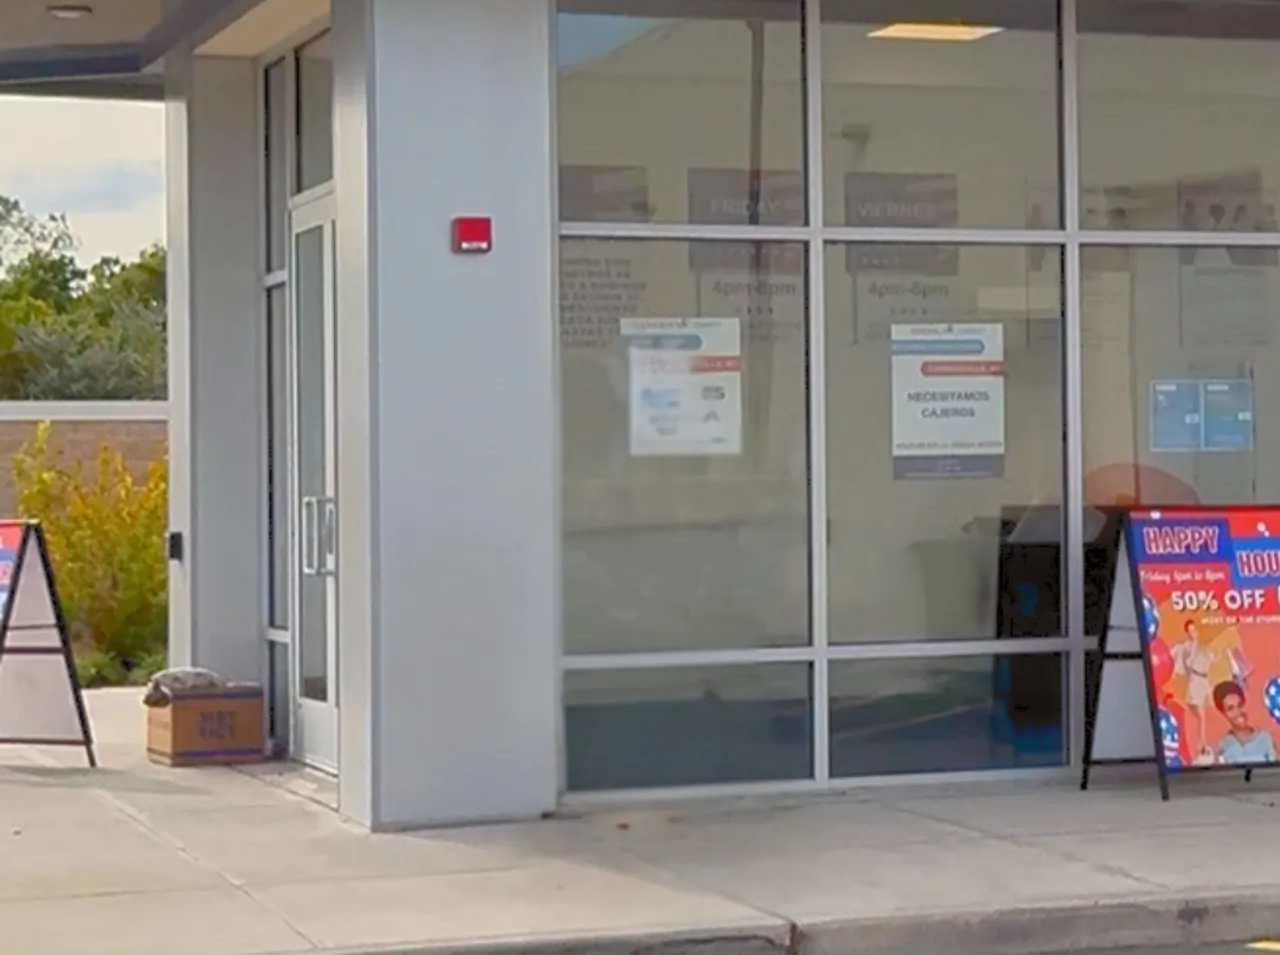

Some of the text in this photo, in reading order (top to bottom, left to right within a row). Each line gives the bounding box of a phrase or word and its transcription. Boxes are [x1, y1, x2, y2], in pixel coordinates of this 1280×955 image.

[906, 390, 991, 403] NECESITAMOS
[920, 406, 977, 419] CAJEROS
[1143, 525, 1220, 554] HAPPY
[1171, 588, 1266, 611] 50% OFF
